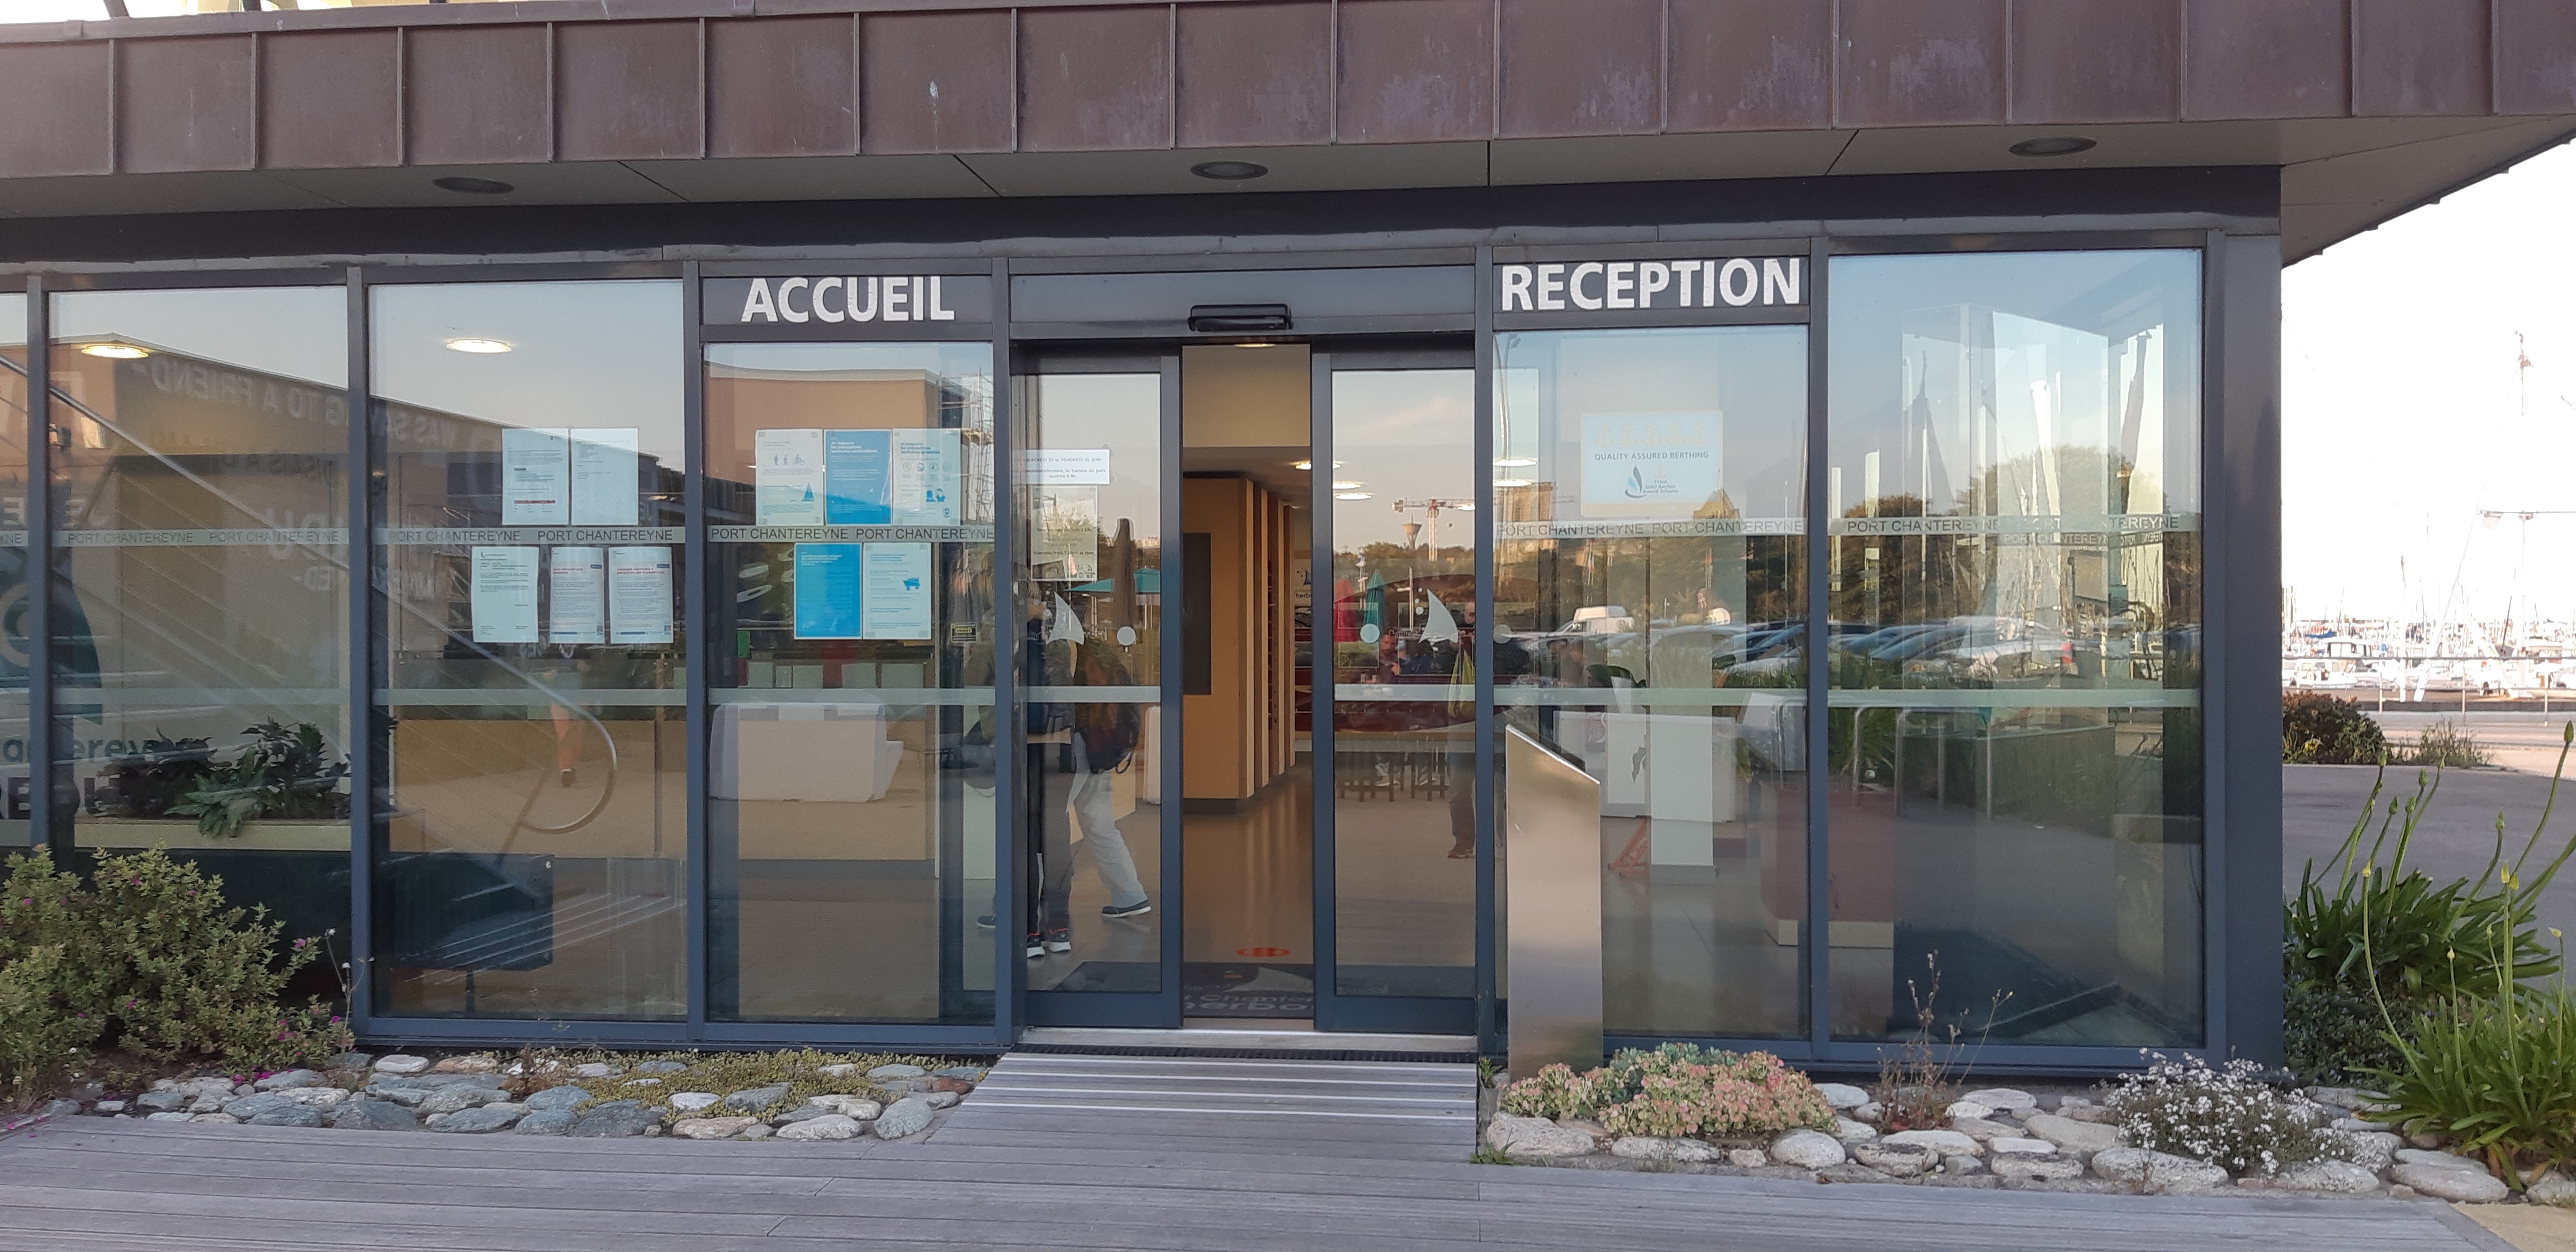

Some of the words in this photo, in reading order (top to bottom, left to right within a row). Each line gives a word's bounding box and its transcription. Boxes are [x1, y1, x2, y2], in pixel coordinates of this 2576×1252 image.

[1502, 258, 1800, 311] RECEPTION
[741, 276, 955, 323] ACCUEIL
[1538, 523, 1644, 535] CHANTEREYNE
[1652, 522, 1690, 534] PORT
[1694, 520, 1804, 534] CHANTEREYNE
[1847, 520, 1888, 532] PORT
[1891, 519, 2001, 532] CHANTEREYNE
[68, 533, 100, 544] PORT
[103, 532, 193, 543] CHANTEREYNE
[210, 532, 242, 543] PORT
[246, 530, 339, 543] CHANTEREYNE
[391, 531, 422, 542] PORT
[426, 530, 520, 542] CHANTEREYNE
[537, 530, 573, 541] PORT
[576, 529, 673, 541] CHANTEREYNE
[711, 528, 747, 539] PORT
[750, 528, 849, 539] CHANTEREYNE
[856, 528, 893, 540] PORT
[896, 528, 995, 540] CHANTEREYNE
